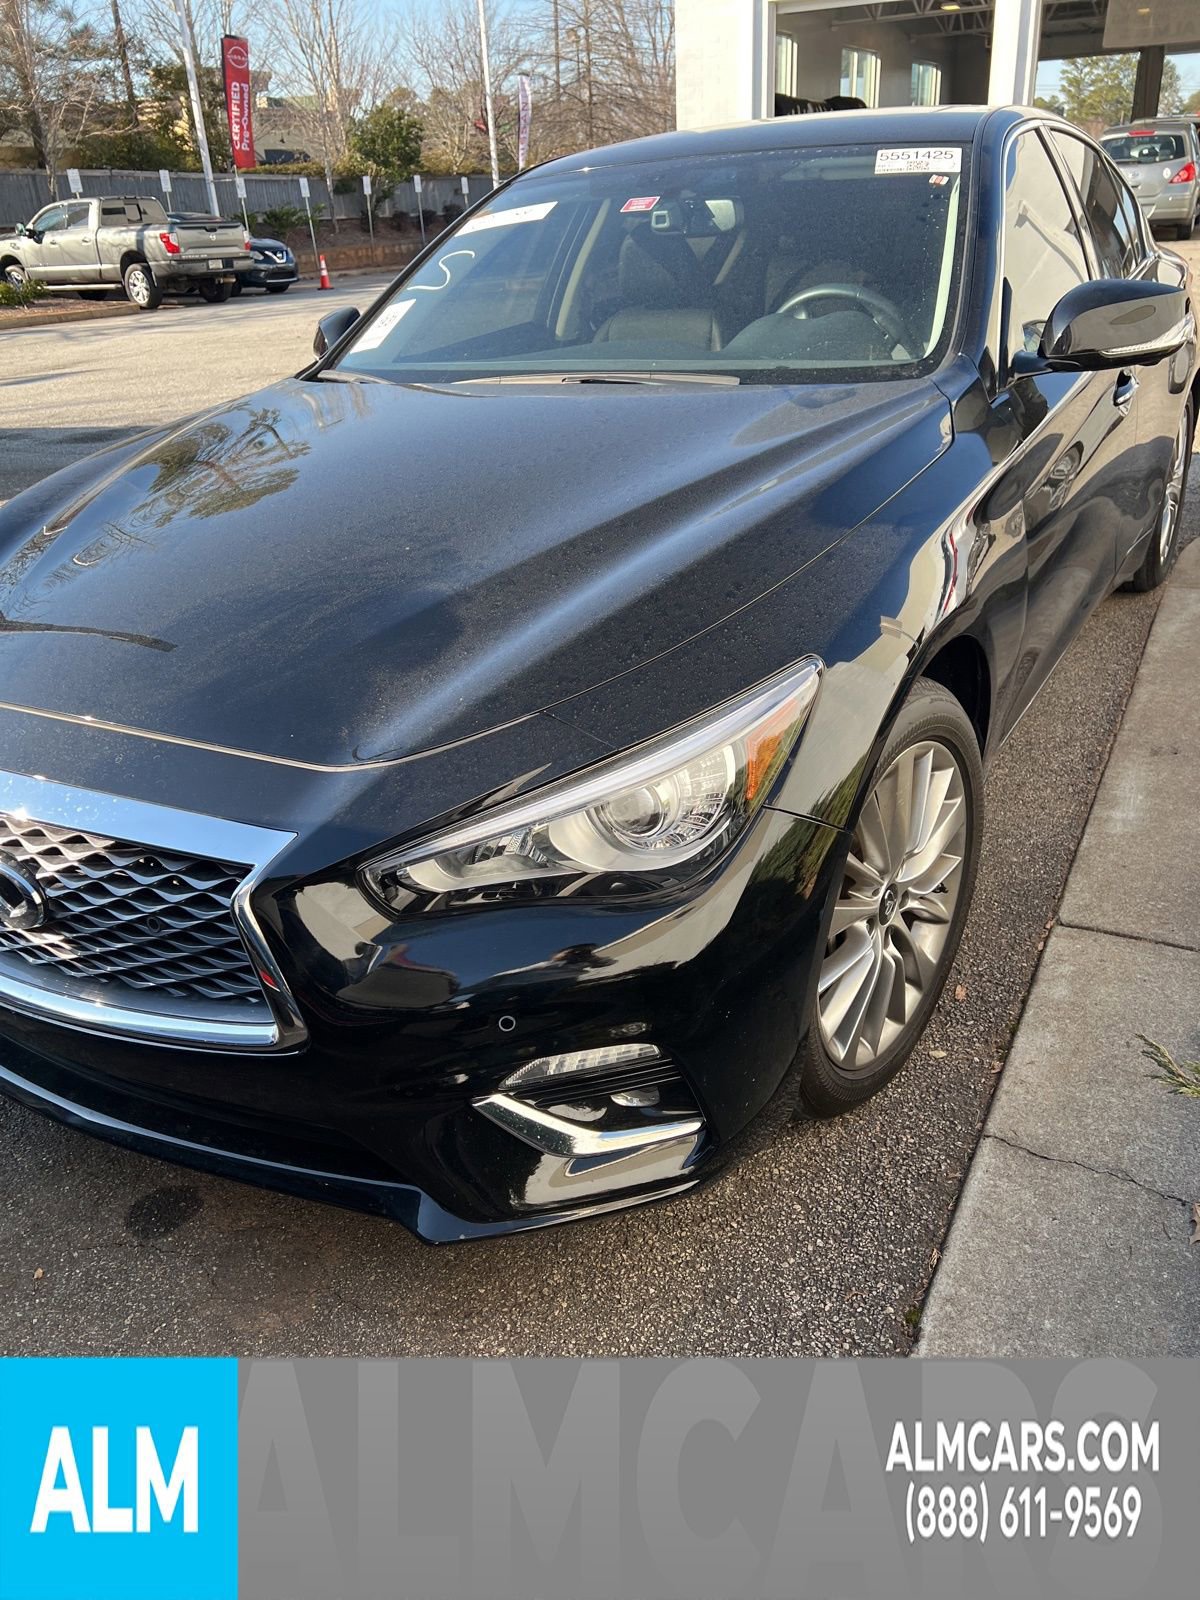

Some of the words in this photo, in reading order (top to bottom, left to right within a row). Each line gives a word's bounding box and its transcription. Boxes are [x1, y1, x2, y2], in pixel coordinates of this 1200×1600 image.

[231, 81, 241, 150] CERTIFIED
[241, 83, 250, 151] Pre-Owned
[880, 150, 954, 161] 5551425
